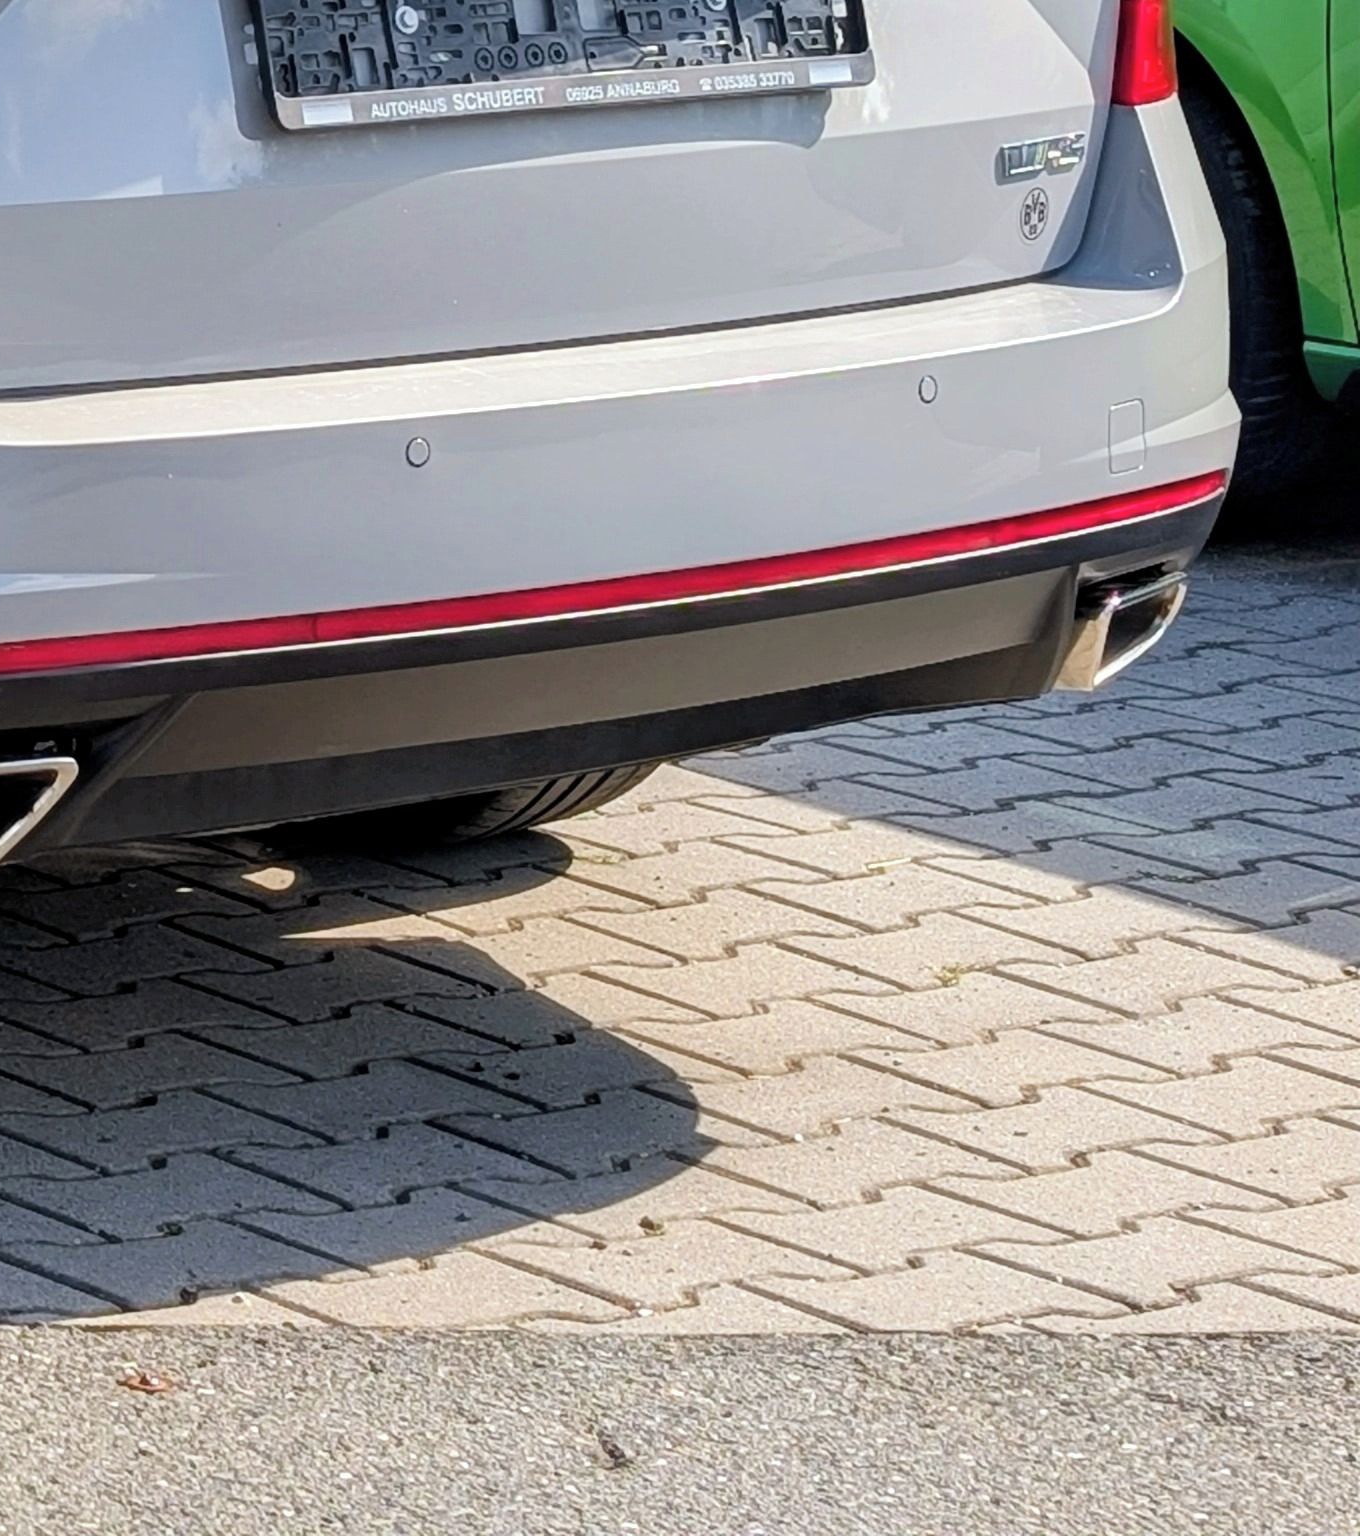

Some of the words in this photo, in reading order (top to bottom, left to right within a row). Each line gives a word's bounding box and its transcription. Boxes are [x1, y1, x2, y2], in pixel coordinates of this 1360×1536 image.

[371, 97, 448, 119] AUTOHAUS
[451, 86, 546, 112] SCHUBERT
[606, 78, 680, 99] ANNABURG
